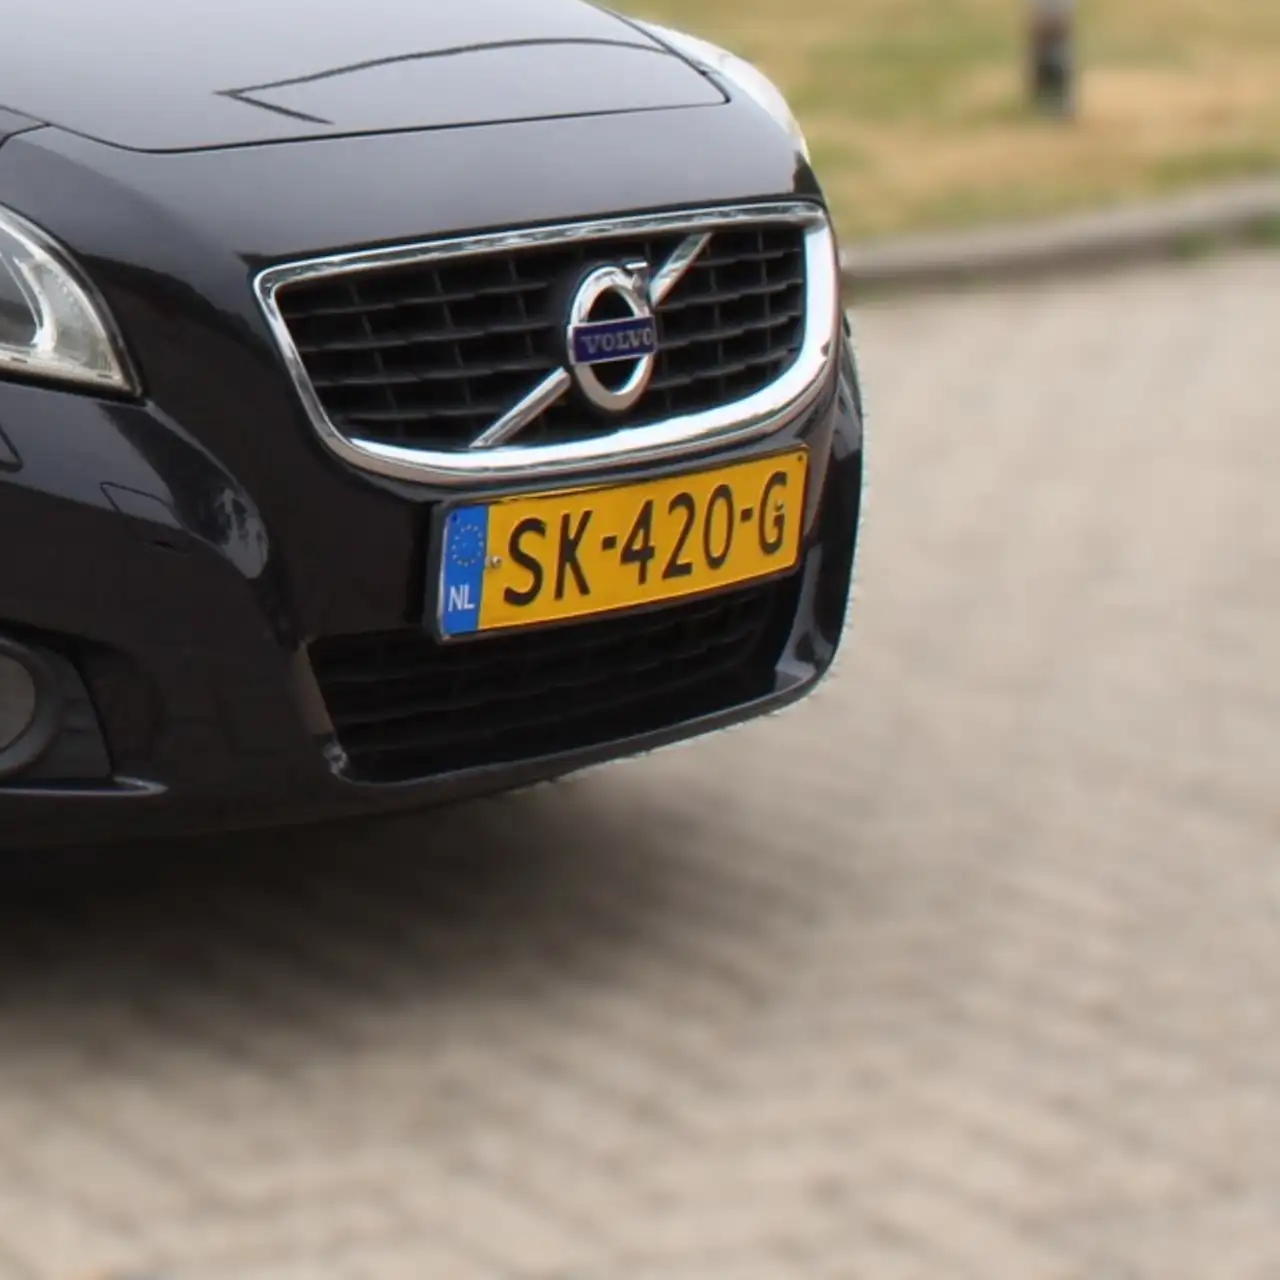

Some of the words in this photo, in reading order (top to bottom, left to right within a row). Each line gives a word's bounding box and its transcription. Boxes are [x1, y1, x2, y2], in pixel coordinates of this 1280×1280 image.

[580, 327, 652, 355] VOLVO
[503, 471, 788, 607] SK-420-G
[448, 584, 475, 612] NL
